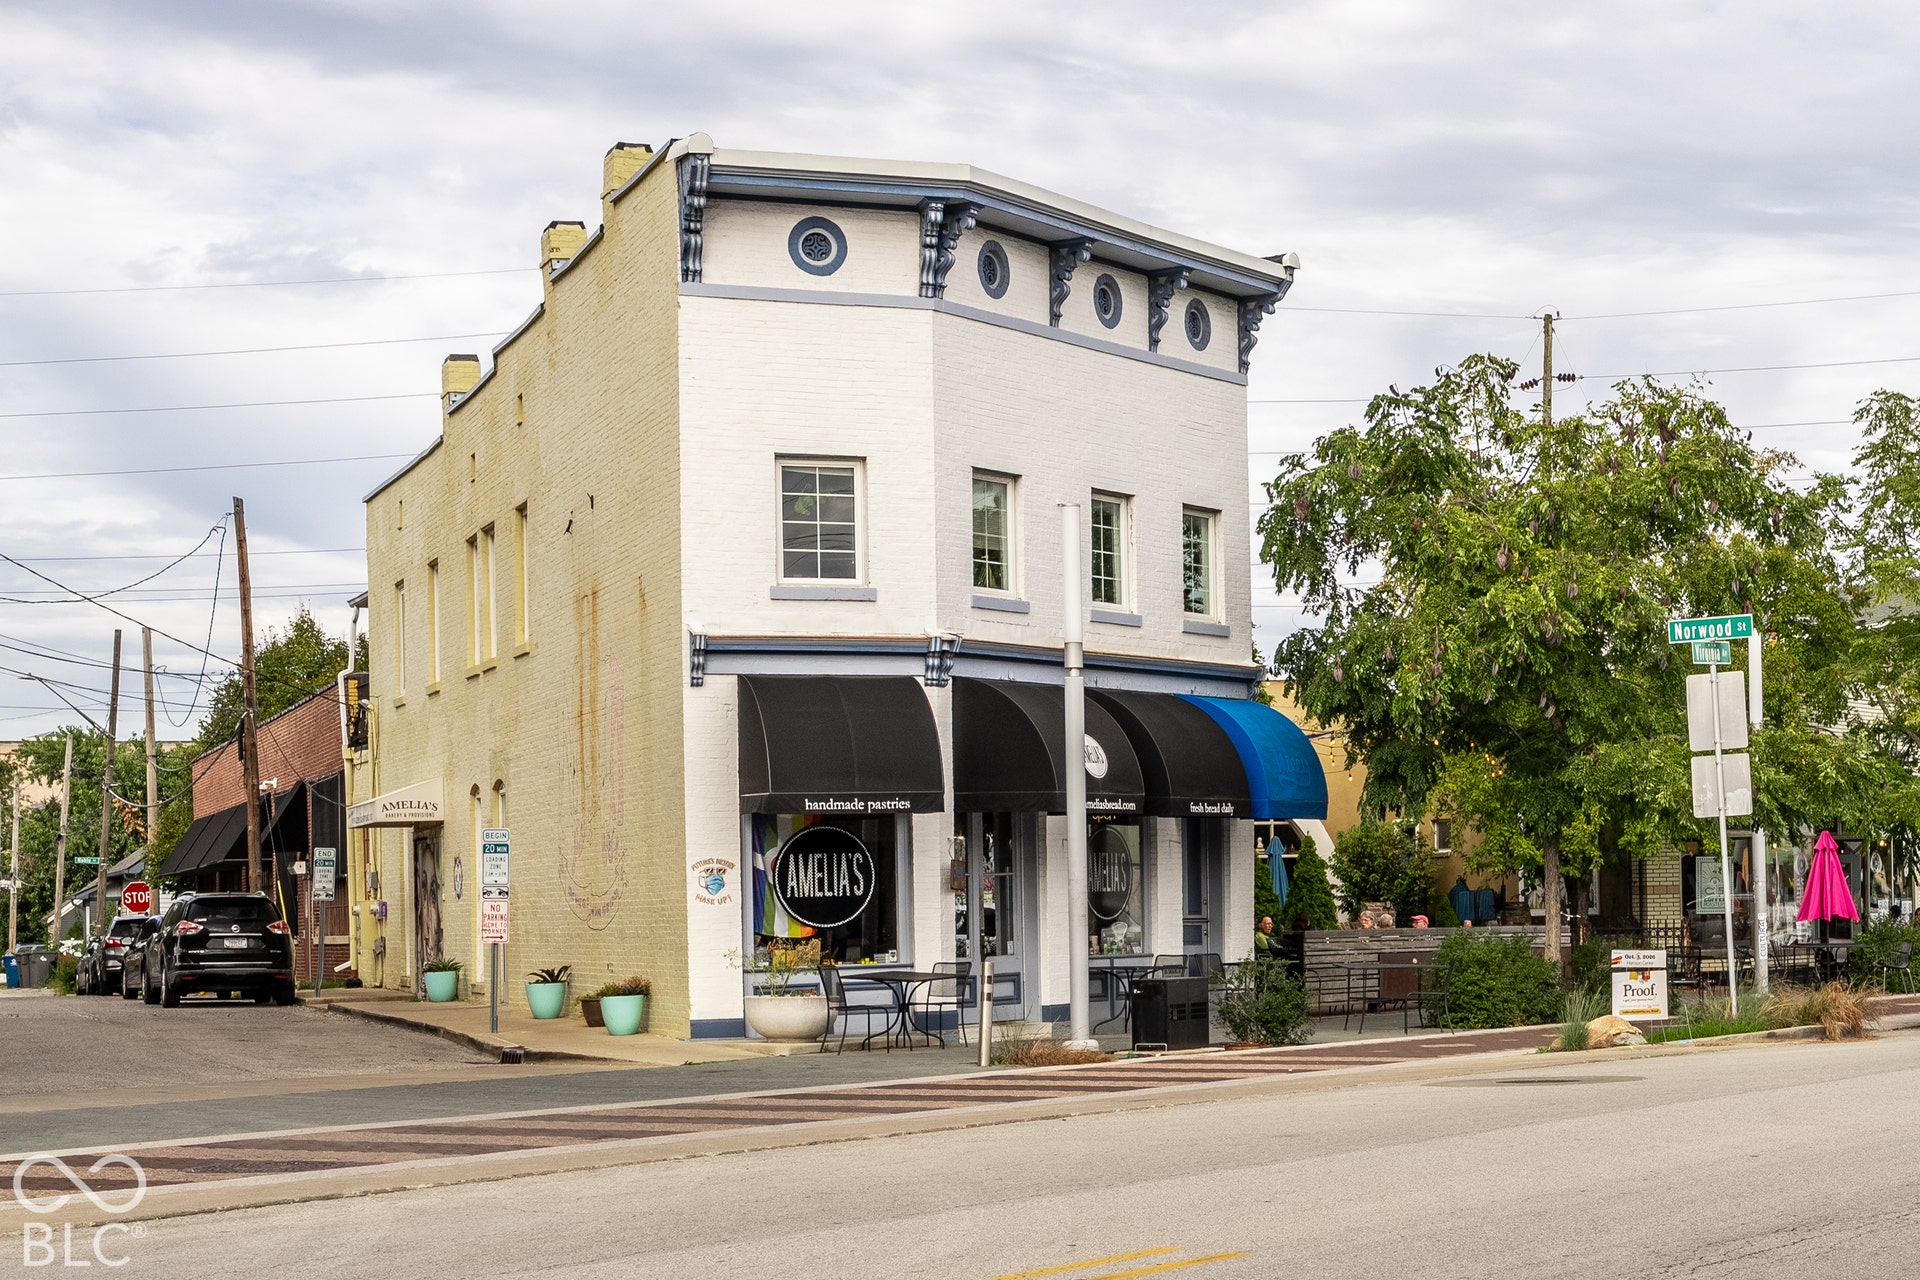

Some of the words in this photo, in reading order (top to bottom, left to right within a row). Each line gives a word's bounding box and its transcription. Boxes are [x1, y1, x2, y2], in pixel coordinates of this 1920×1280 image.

[1674, 619, 1732, 640] Norwood
[1737, 621, 1747, 632] St
[1695, 644, 1721, 662] Virginia
[381, 800, 438, 812] AMELIA'S
[805, 798, 864, 810] handmade
[868, 797, 911, 813] pastries
[1190, 802, 1204, 813] fresh
[1204, 802, 1220, 813] bread
[1221, 802, 1234, 816] daily
[485, 844, 495, 853] 20
[496, 845, 508, 853] MIN
[786, 852, 864, 897] AMELIA'S
[490, 904, 501, 912] NO
[1623, 983, 1658, 997] Proof.
